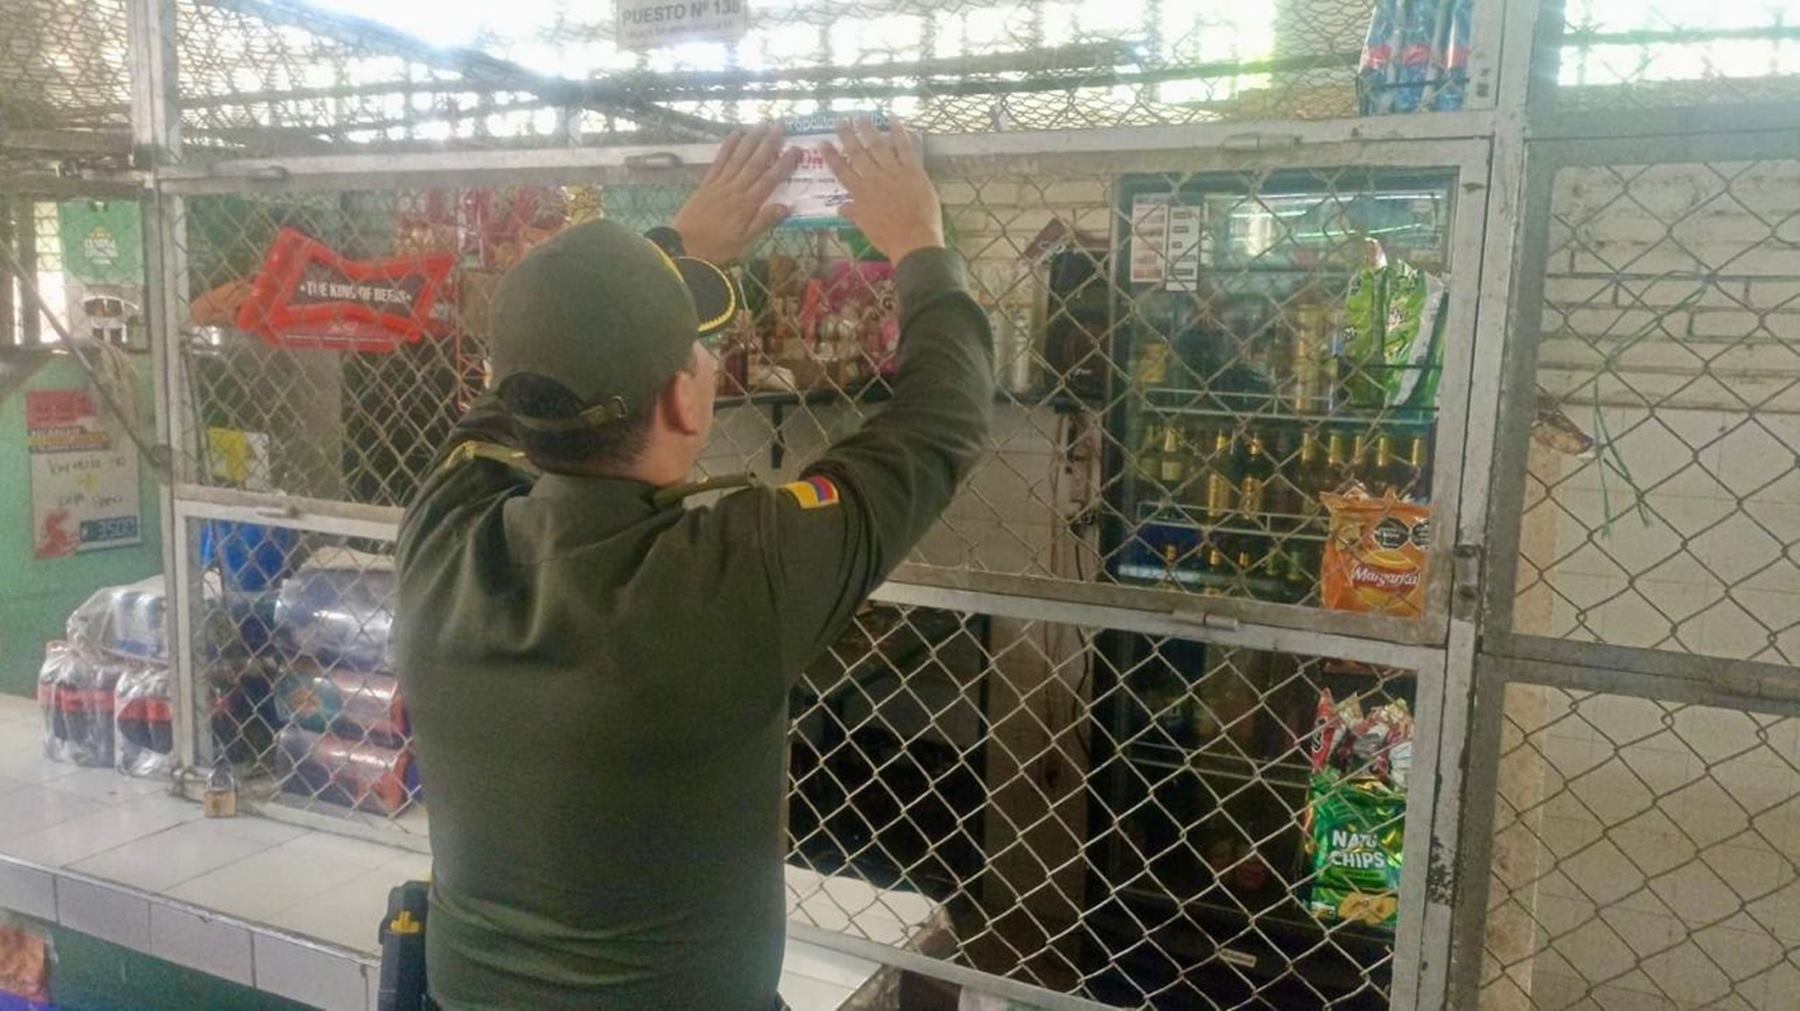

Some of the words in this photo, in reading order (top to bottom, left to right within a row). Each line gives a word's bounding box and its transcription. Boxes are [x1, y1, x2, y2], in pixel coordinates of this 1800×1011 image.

[622, 3, 686, 25] PUESTO
[358, 286, 372, 301] OF
[1330, 850, 1386, 868] CHIPS
